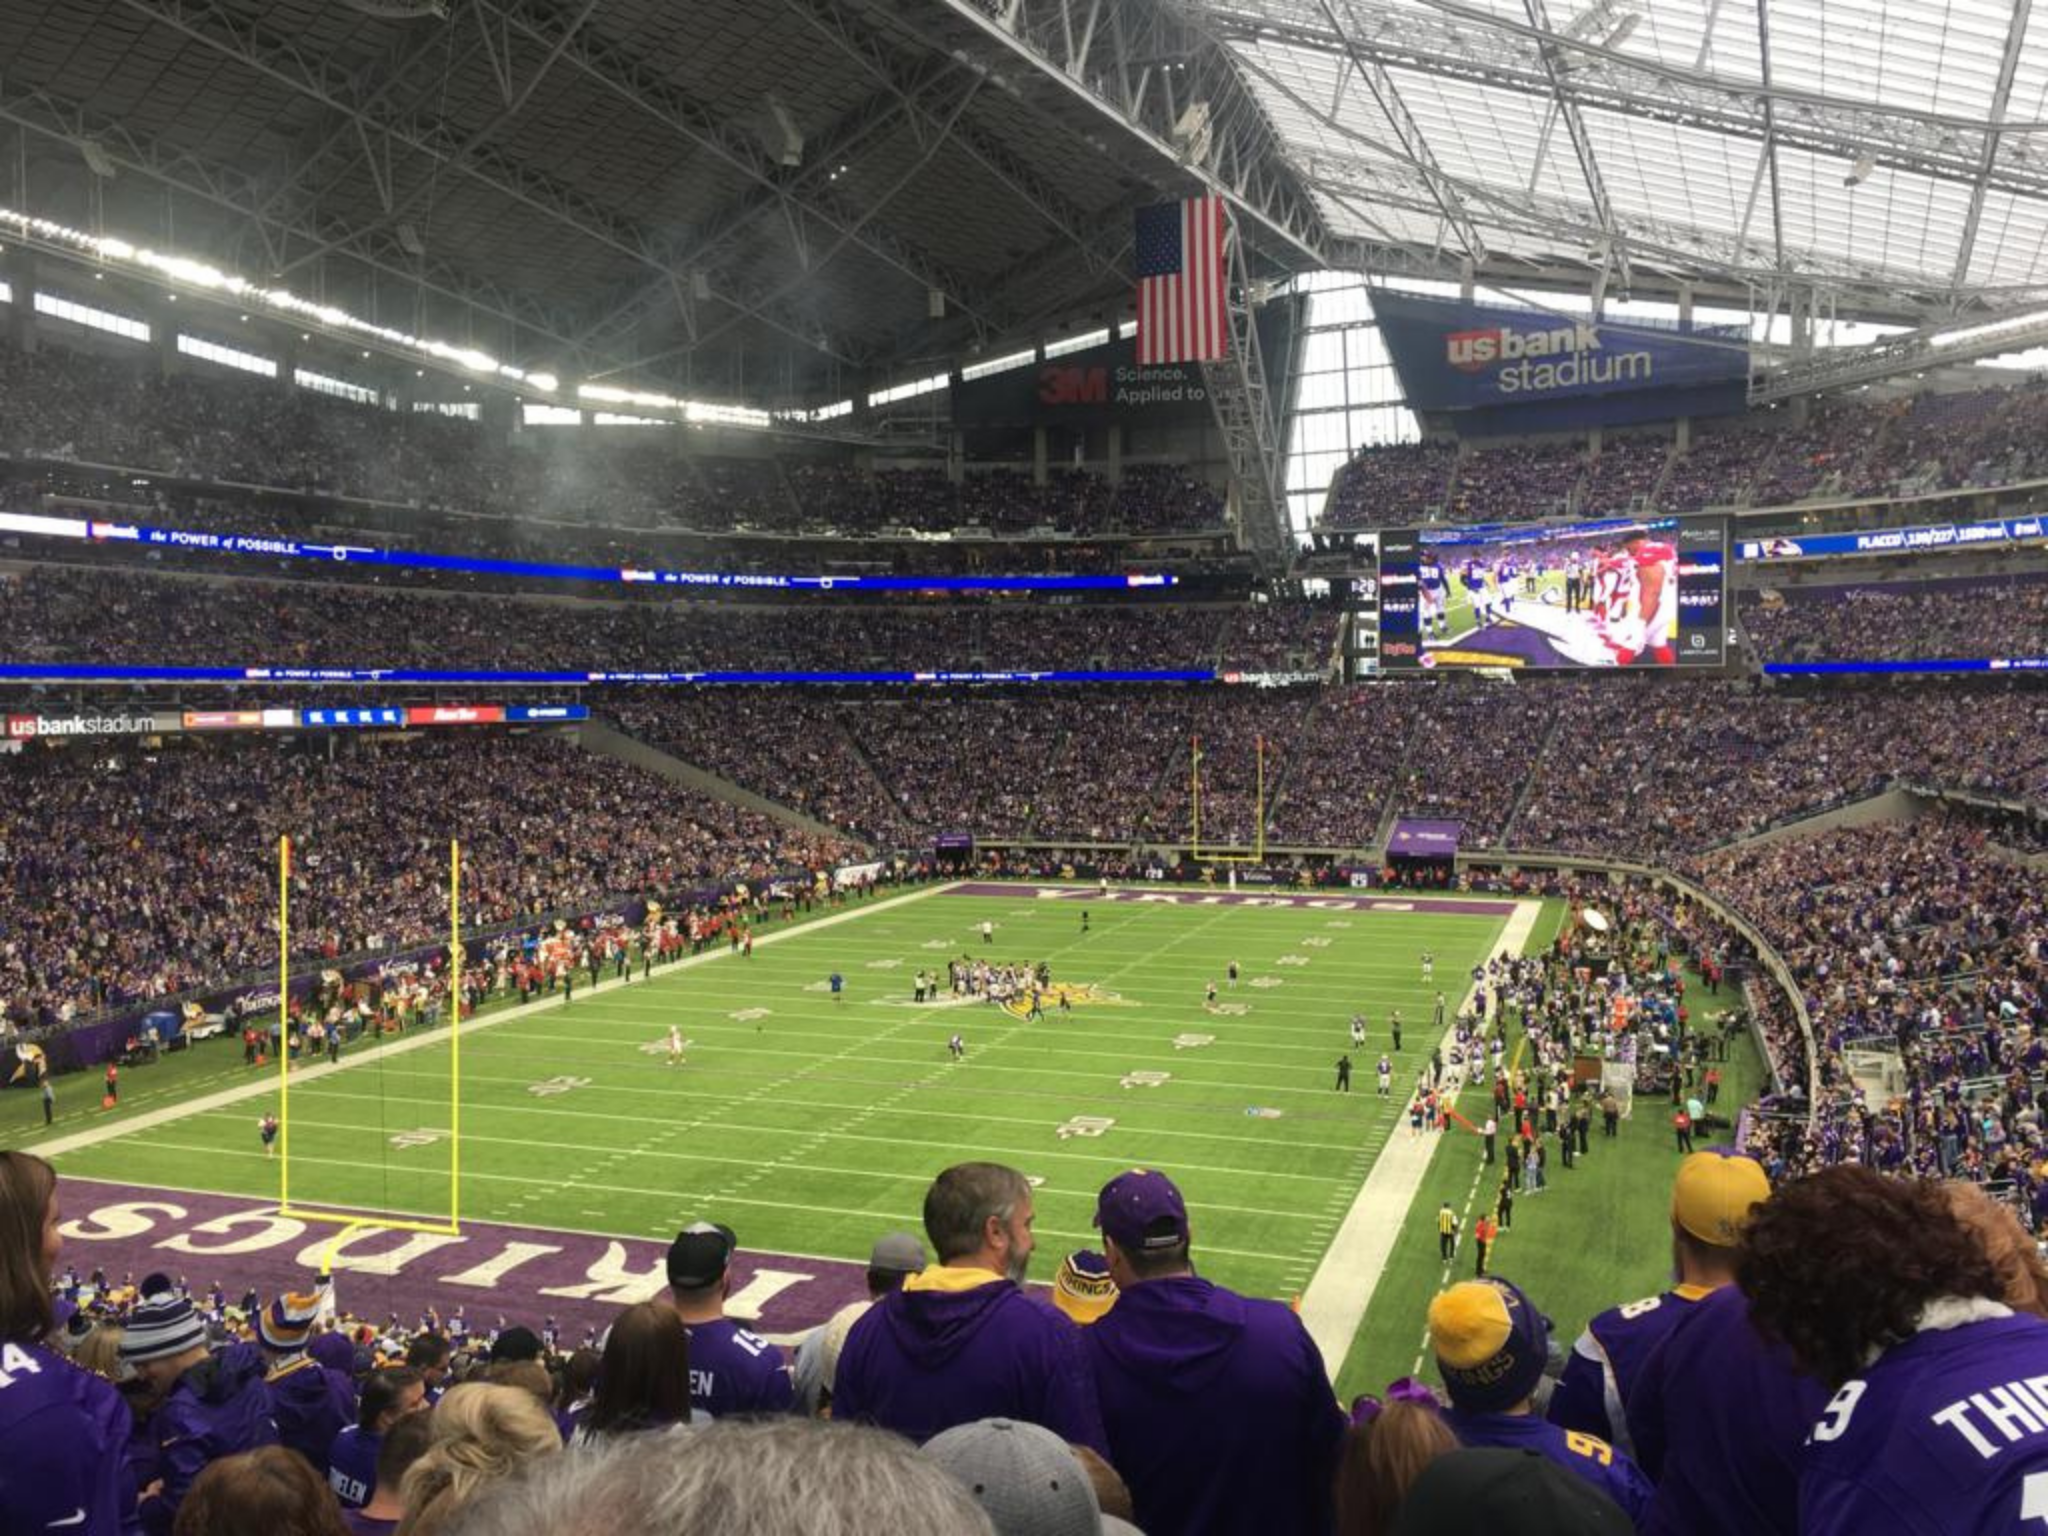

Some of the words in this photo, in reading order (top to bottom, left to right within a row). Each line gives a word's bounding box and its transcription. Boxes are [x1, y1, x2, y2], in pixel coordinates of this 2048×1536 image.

[1117, 366, 1189, 382] Science.
[1500, 351, 1652, 393] stadium
[1040, 366, 1107, 402] 3M
[1117, 385, 1183, 404] Applied
[1186, 387, 1205, 400] to
[171, 532, 219, 546] POWER
[237, 538, 300, 554] POSSIBLE.
[681, 574, 719, 584] POWER
